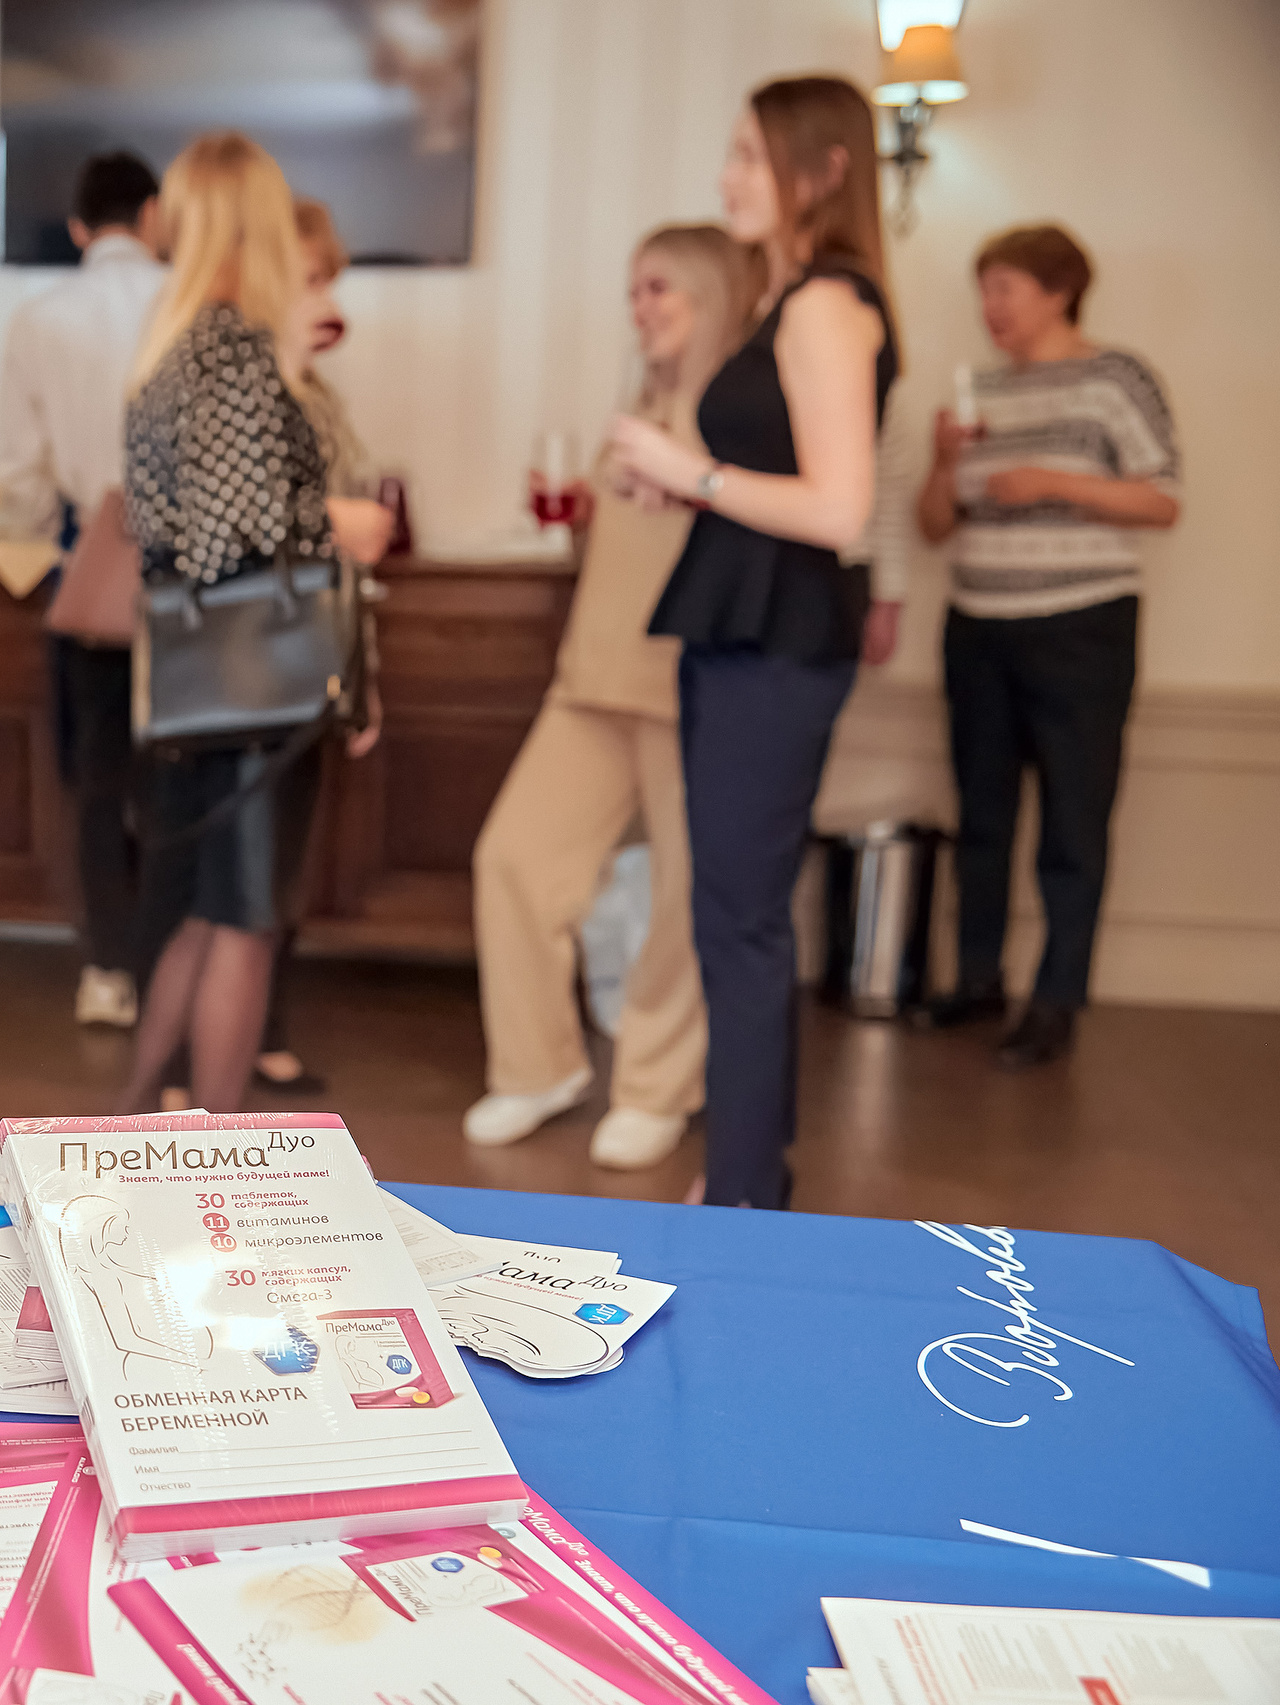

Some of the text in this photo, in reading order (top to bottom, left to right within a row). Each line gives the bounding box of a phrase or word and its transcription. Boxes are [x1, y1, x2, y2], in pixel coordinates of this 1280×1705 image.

[59, 1131, 315, 1178] ПреМама Дуо
[119, 1169, 330, 1184] Знает, что нужно будущей маме!
[195, 1193, 225, 1209] 30
[234, 1198, 309, 1209] содержащих
[206, 1214, 329, 1229] 11 витаминов
[213, 1231, 384, 1250] 10 микроэлементов
[224, 1269, 257, 1286] 30
[497, 1261, 581, 1291] ама
[588, 1303, 618, 1324] ДГК
[325, 1322, 382, 1334] ПреМама
[392, 1358, 408, 1370] ДГК
[114, 1386, 308, 1409] ОБМЕННАЯ КАРТА
[121, 1410, 270, 1433] БЕРЕМЕННОЙ
[128, 1444, 179, 1457] Фамилия
[134, 1464, 160, 1475] Имя
[139, 1480, 191, 1492] Отчество
